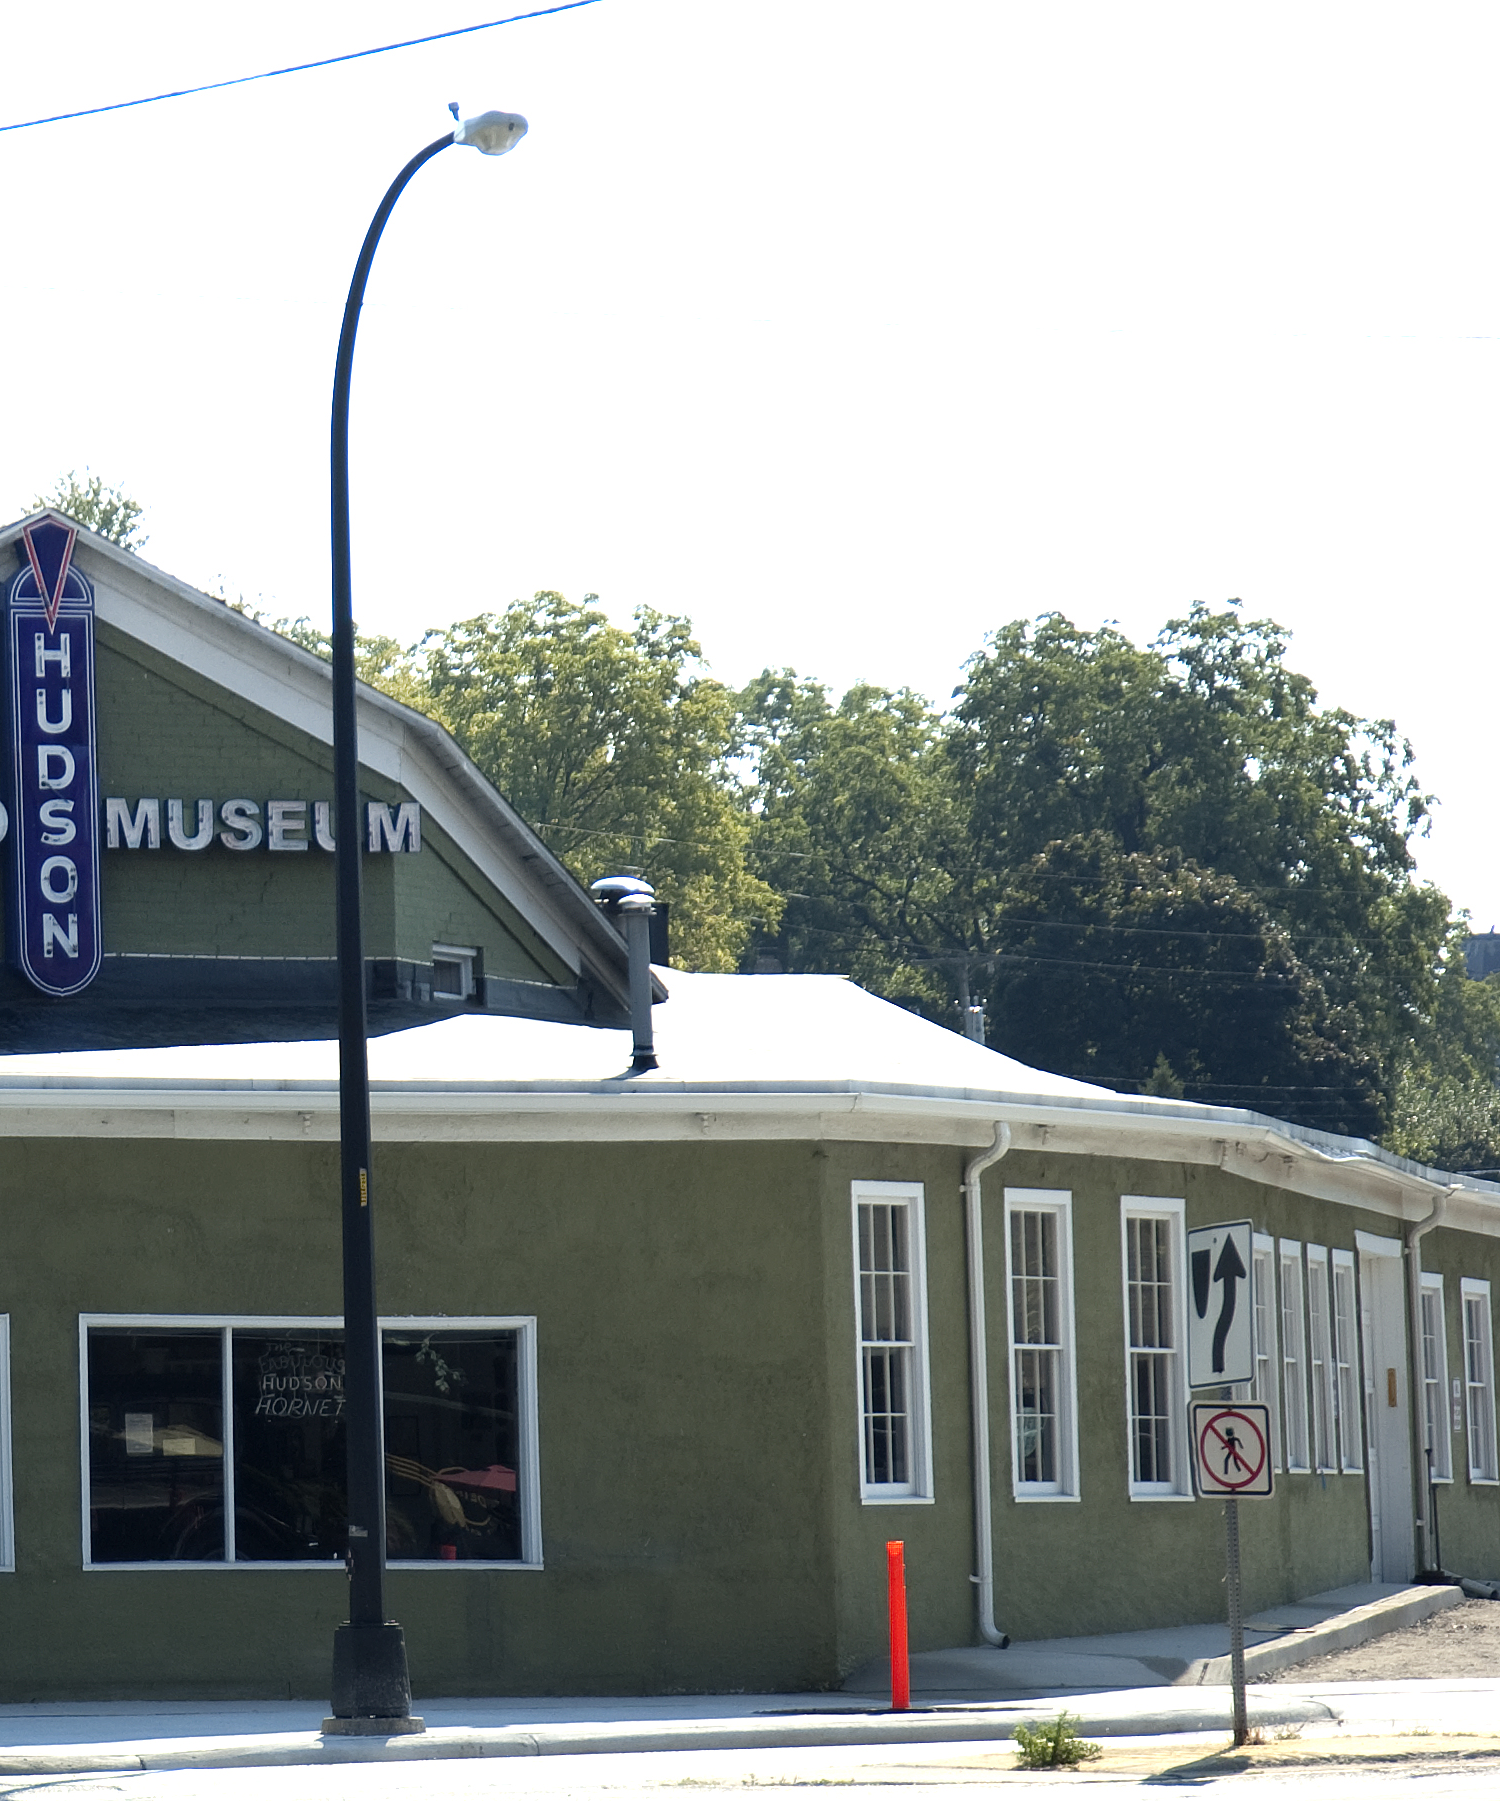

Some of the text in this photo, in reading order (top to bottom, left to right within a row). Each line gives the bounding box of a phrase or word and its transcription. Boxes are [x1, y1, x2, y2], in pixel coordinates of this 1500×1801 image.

[34, 631, 79, 959] HUDSON
[263, 1376, 341, 1391] HUDSON
[255, 1397, 346, 1417] HORNET
